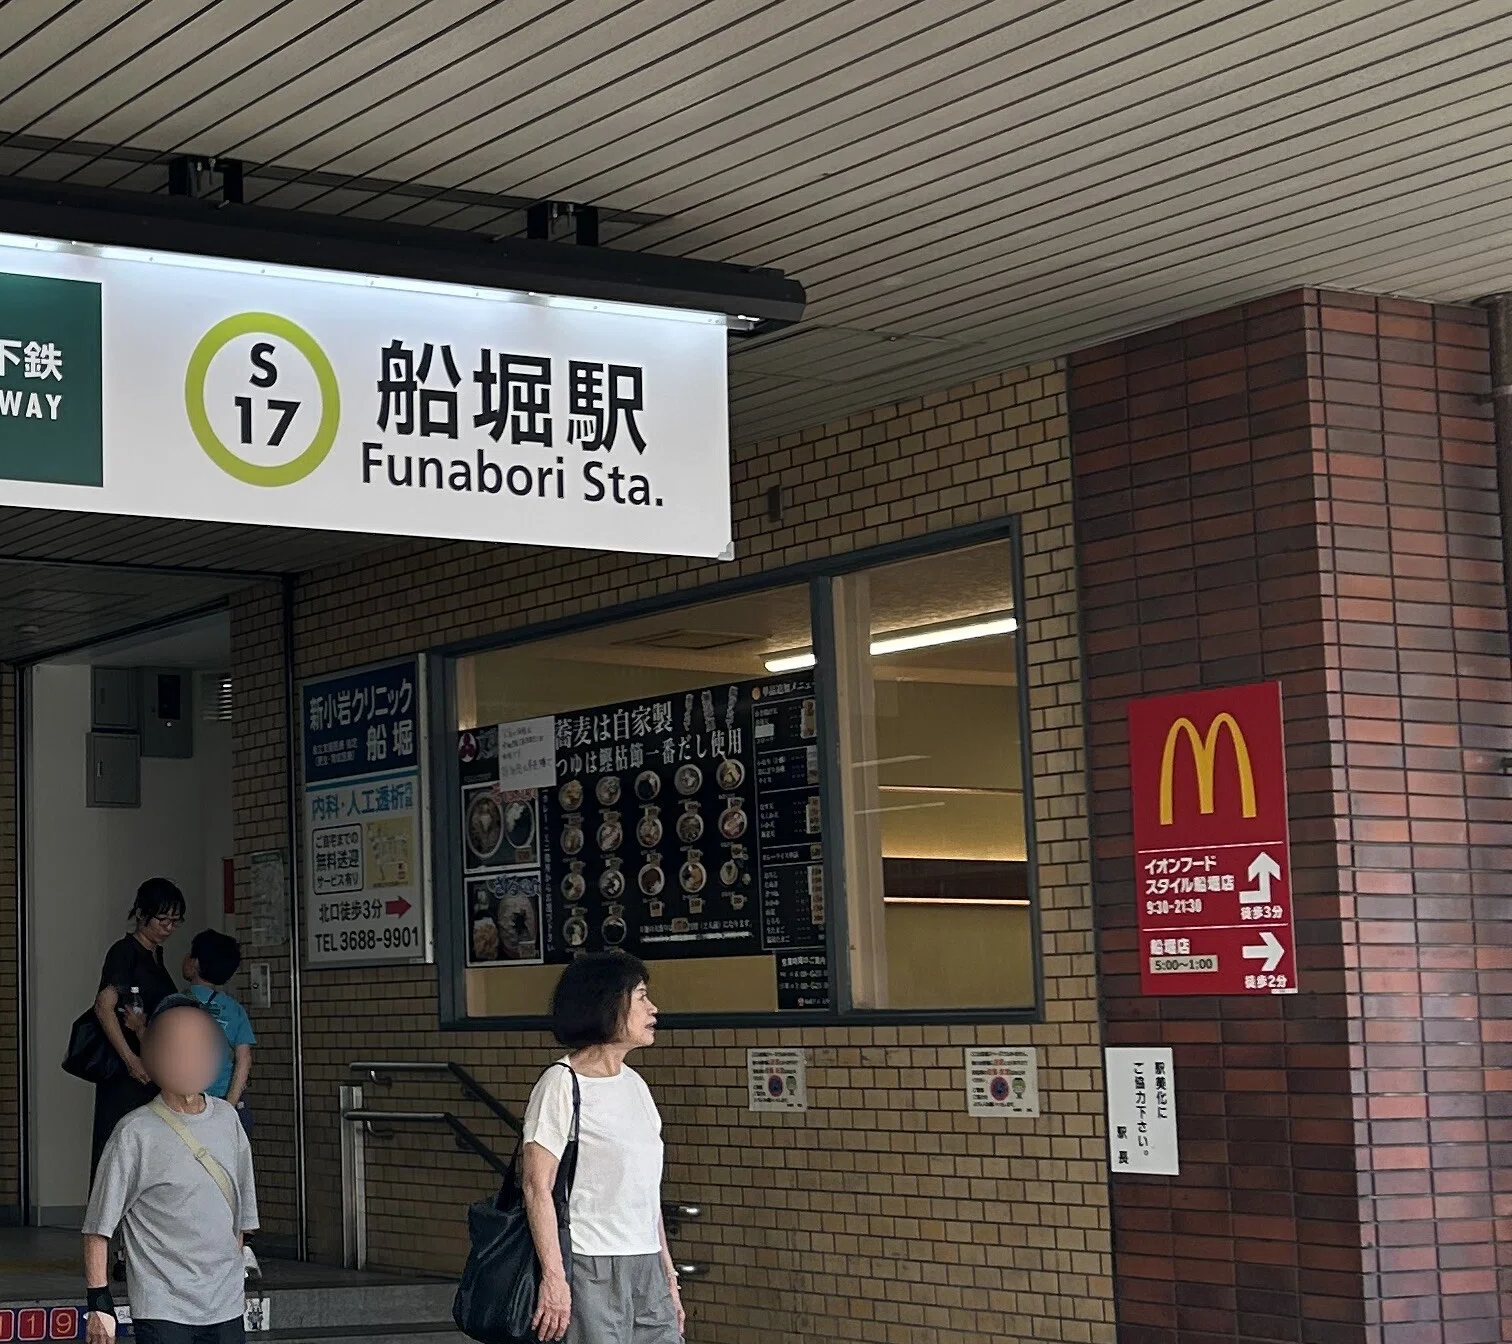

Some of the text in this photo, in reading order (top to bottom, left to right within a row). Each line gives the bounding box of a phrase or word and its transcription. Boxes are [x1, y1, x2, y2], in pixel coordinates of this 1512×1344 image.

[249, 342, 278, 389] S
[376, 339, 648, 455] 船堀駅
[234, 395, 302, 447] 17
[361, 441, 664, 507] Funabori Sta.
[309, 676, 413, 731] 新小岩クリニック
[366, 718, 414, 762] 船堀
[554, 701, 673, 751] 蕎麦は自家製
[315, 849, 360, 872] 無料送迎
[317, 872, 359, 889] サービス有り
[1144, 855, 1217, 875] イオンフード
[318, 898, 383, 924] 北口徒歩3分
[1240, 904, 1284, 921] 徒歩3分
[315, 926, 419, 953] TEL 3688-9901
[1244, 974, 1288, 989] 徒歩2分
[1154, 1061, 1168, 1119] 駅美化に
